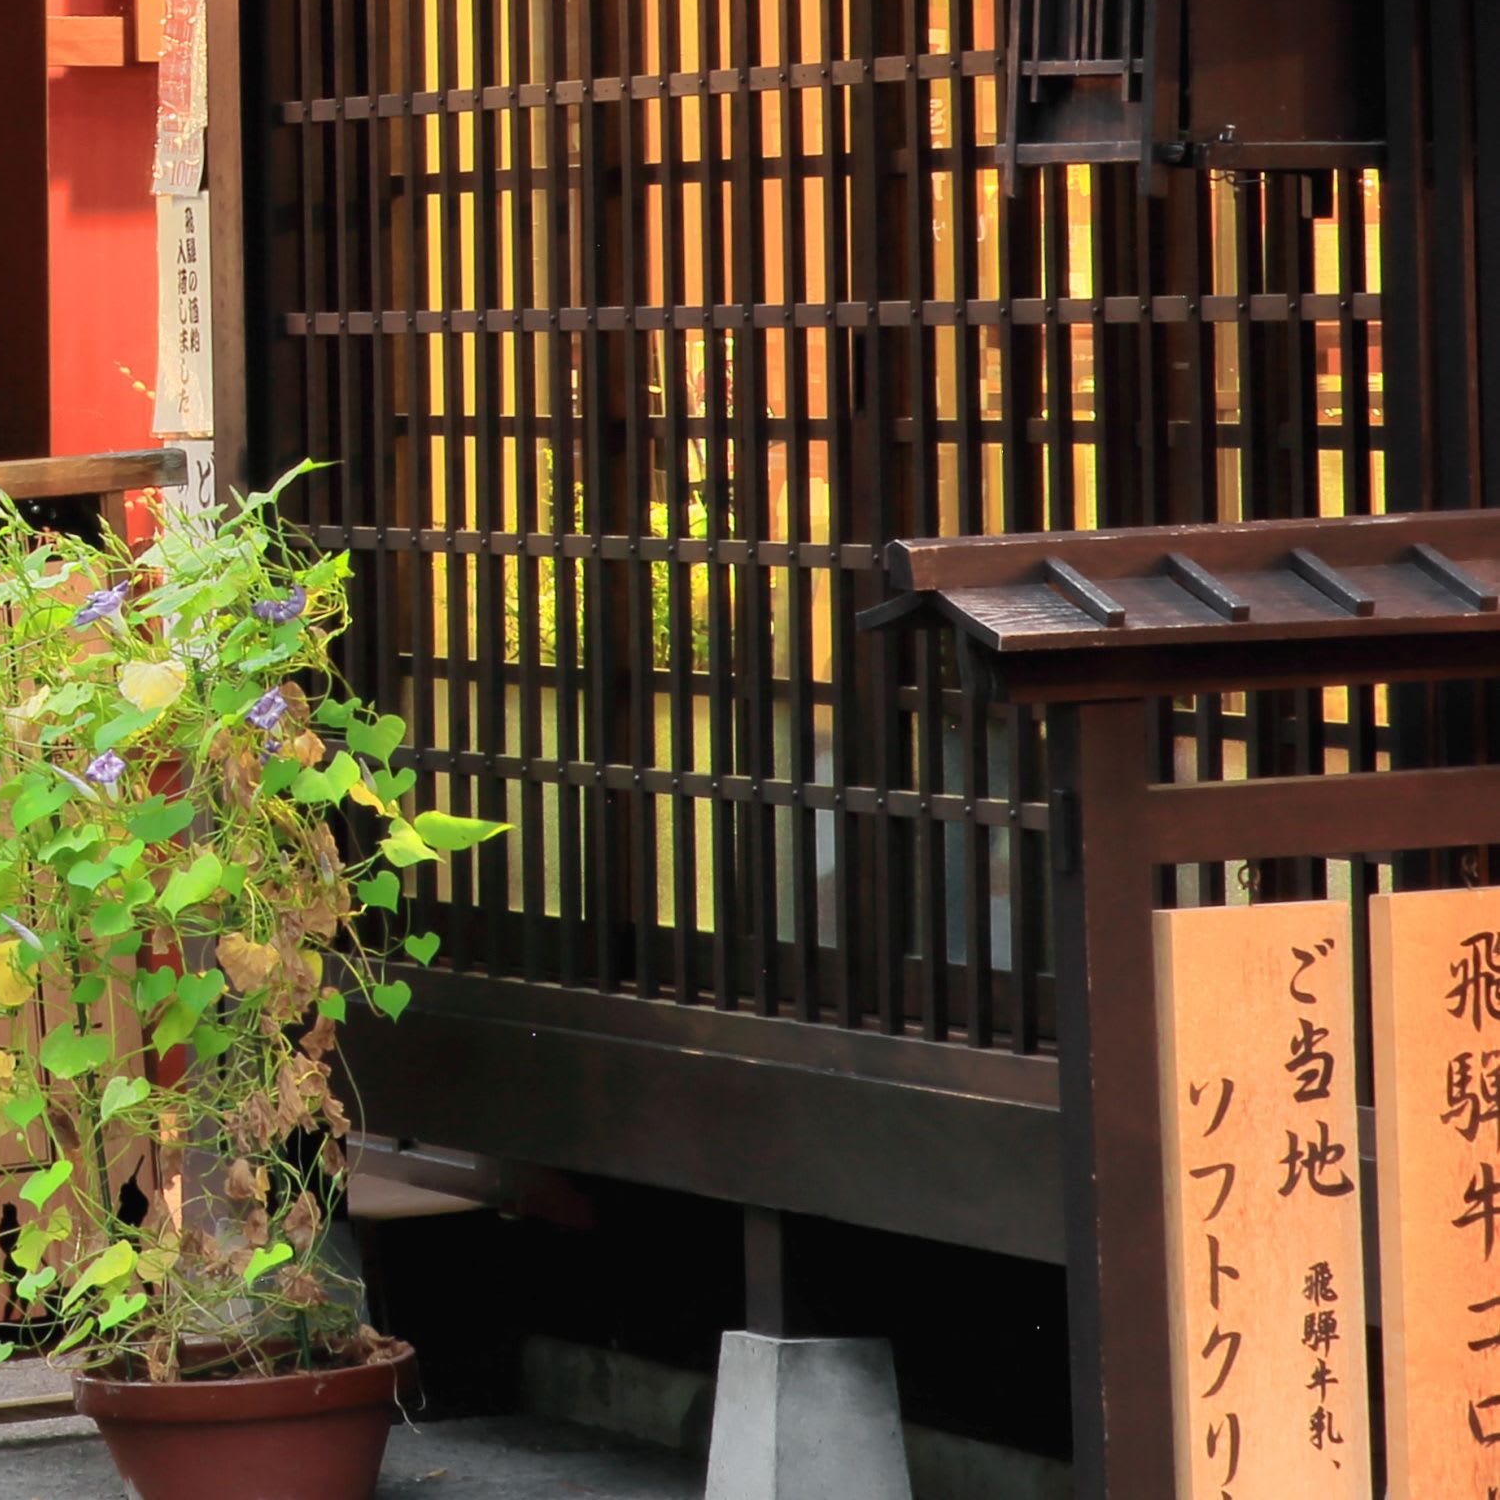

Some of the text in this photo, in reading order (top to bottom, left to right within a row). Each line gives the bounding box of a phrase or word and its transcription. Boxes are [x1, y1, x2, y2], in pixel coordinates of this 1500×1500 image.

[1277, 937, 1355, 1199] ご当地
[1440, 930, 1500, 1500] 飛騨牛コロ
[1188, 1076, 1242, 1500] ソフトクリ
